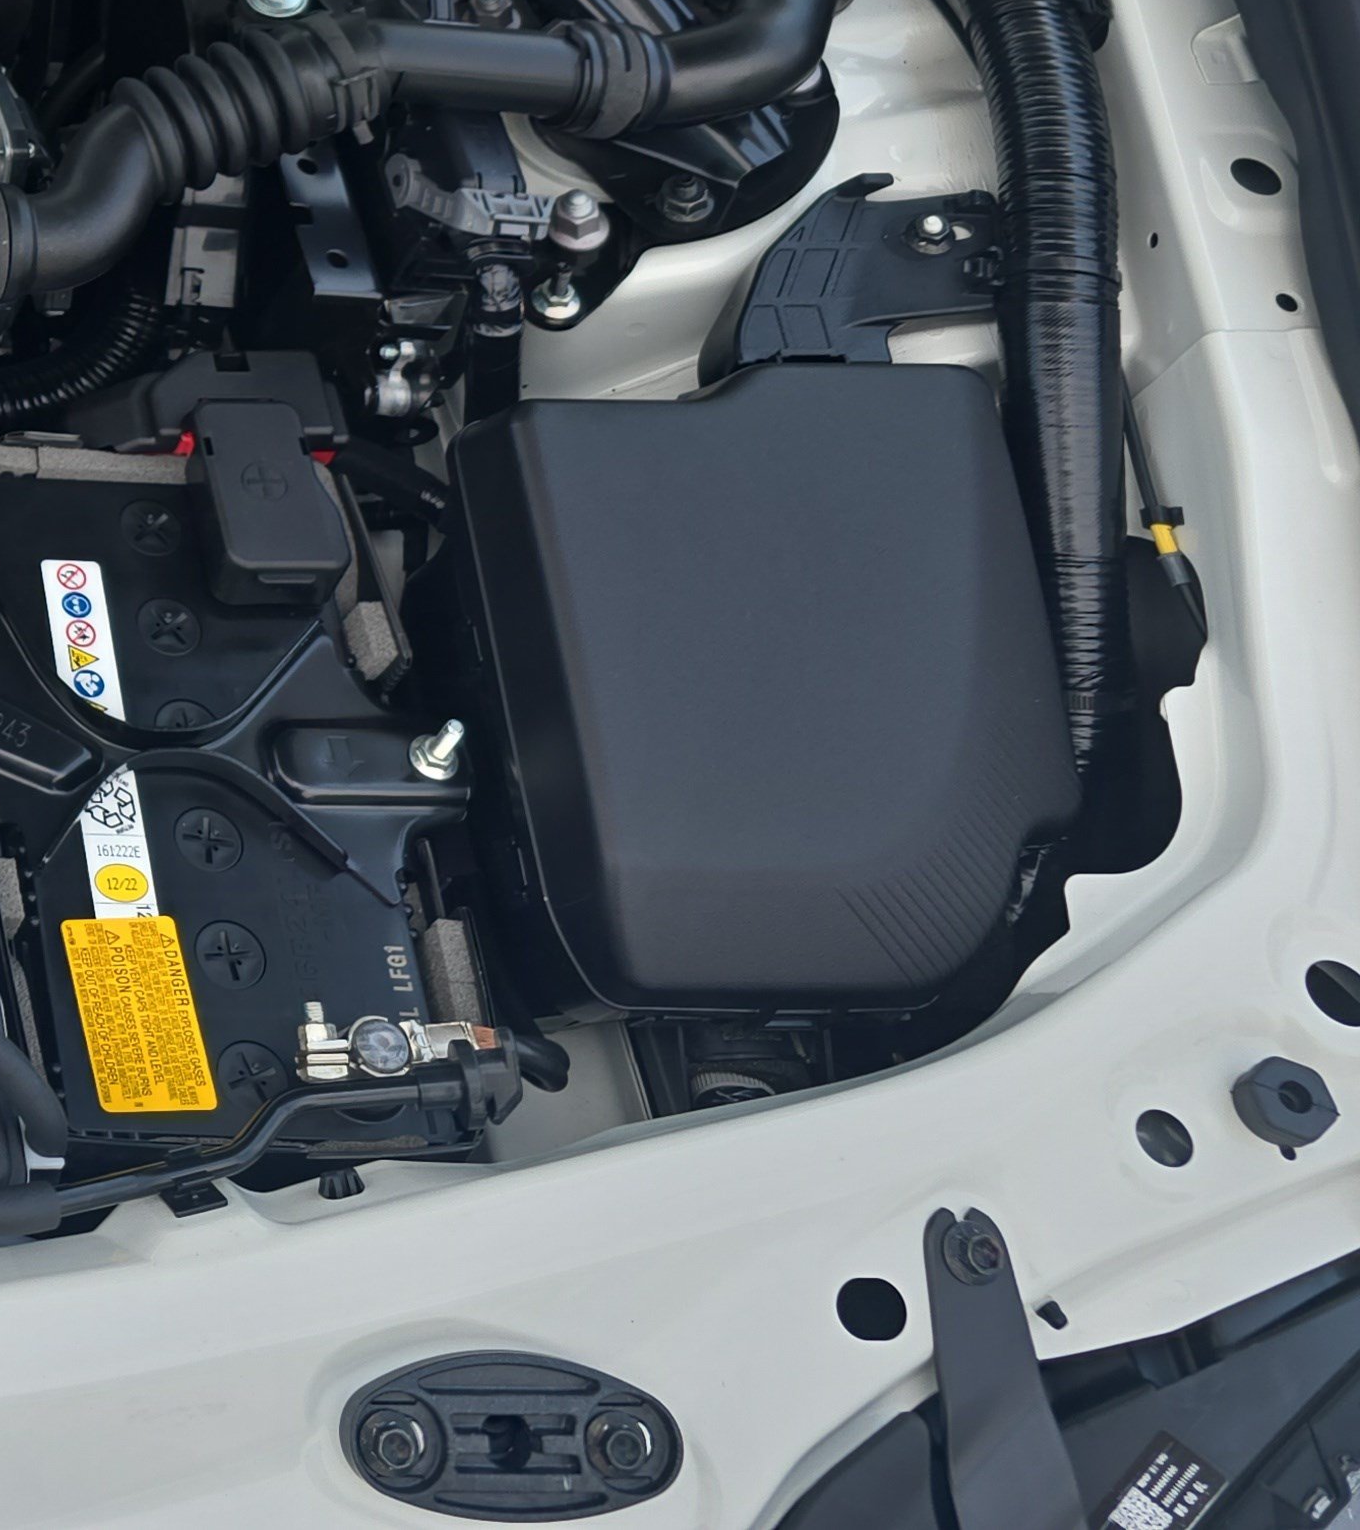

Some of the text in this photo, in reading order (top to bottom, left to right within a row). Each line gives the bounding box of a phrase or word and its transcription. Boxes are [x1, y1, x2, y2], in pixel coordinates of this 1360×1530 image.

[96, 844, 141, 859] 161222E
[106, 877, 138, 891] 12/22
[78, 947, 118, 1085] KEEP OUT OF REACH OF CHILDREN
[108, 946, 152, 1095] POISON CAUSES SEVERE BURNS
[122, 944, 165, 1085] KEEP VENT CAPS TIGHT AND LEVEL
[164, 950, 206, 1086] DANGER EXPLOSIVE GASES
[386, 945, 414, 992] LFG1
